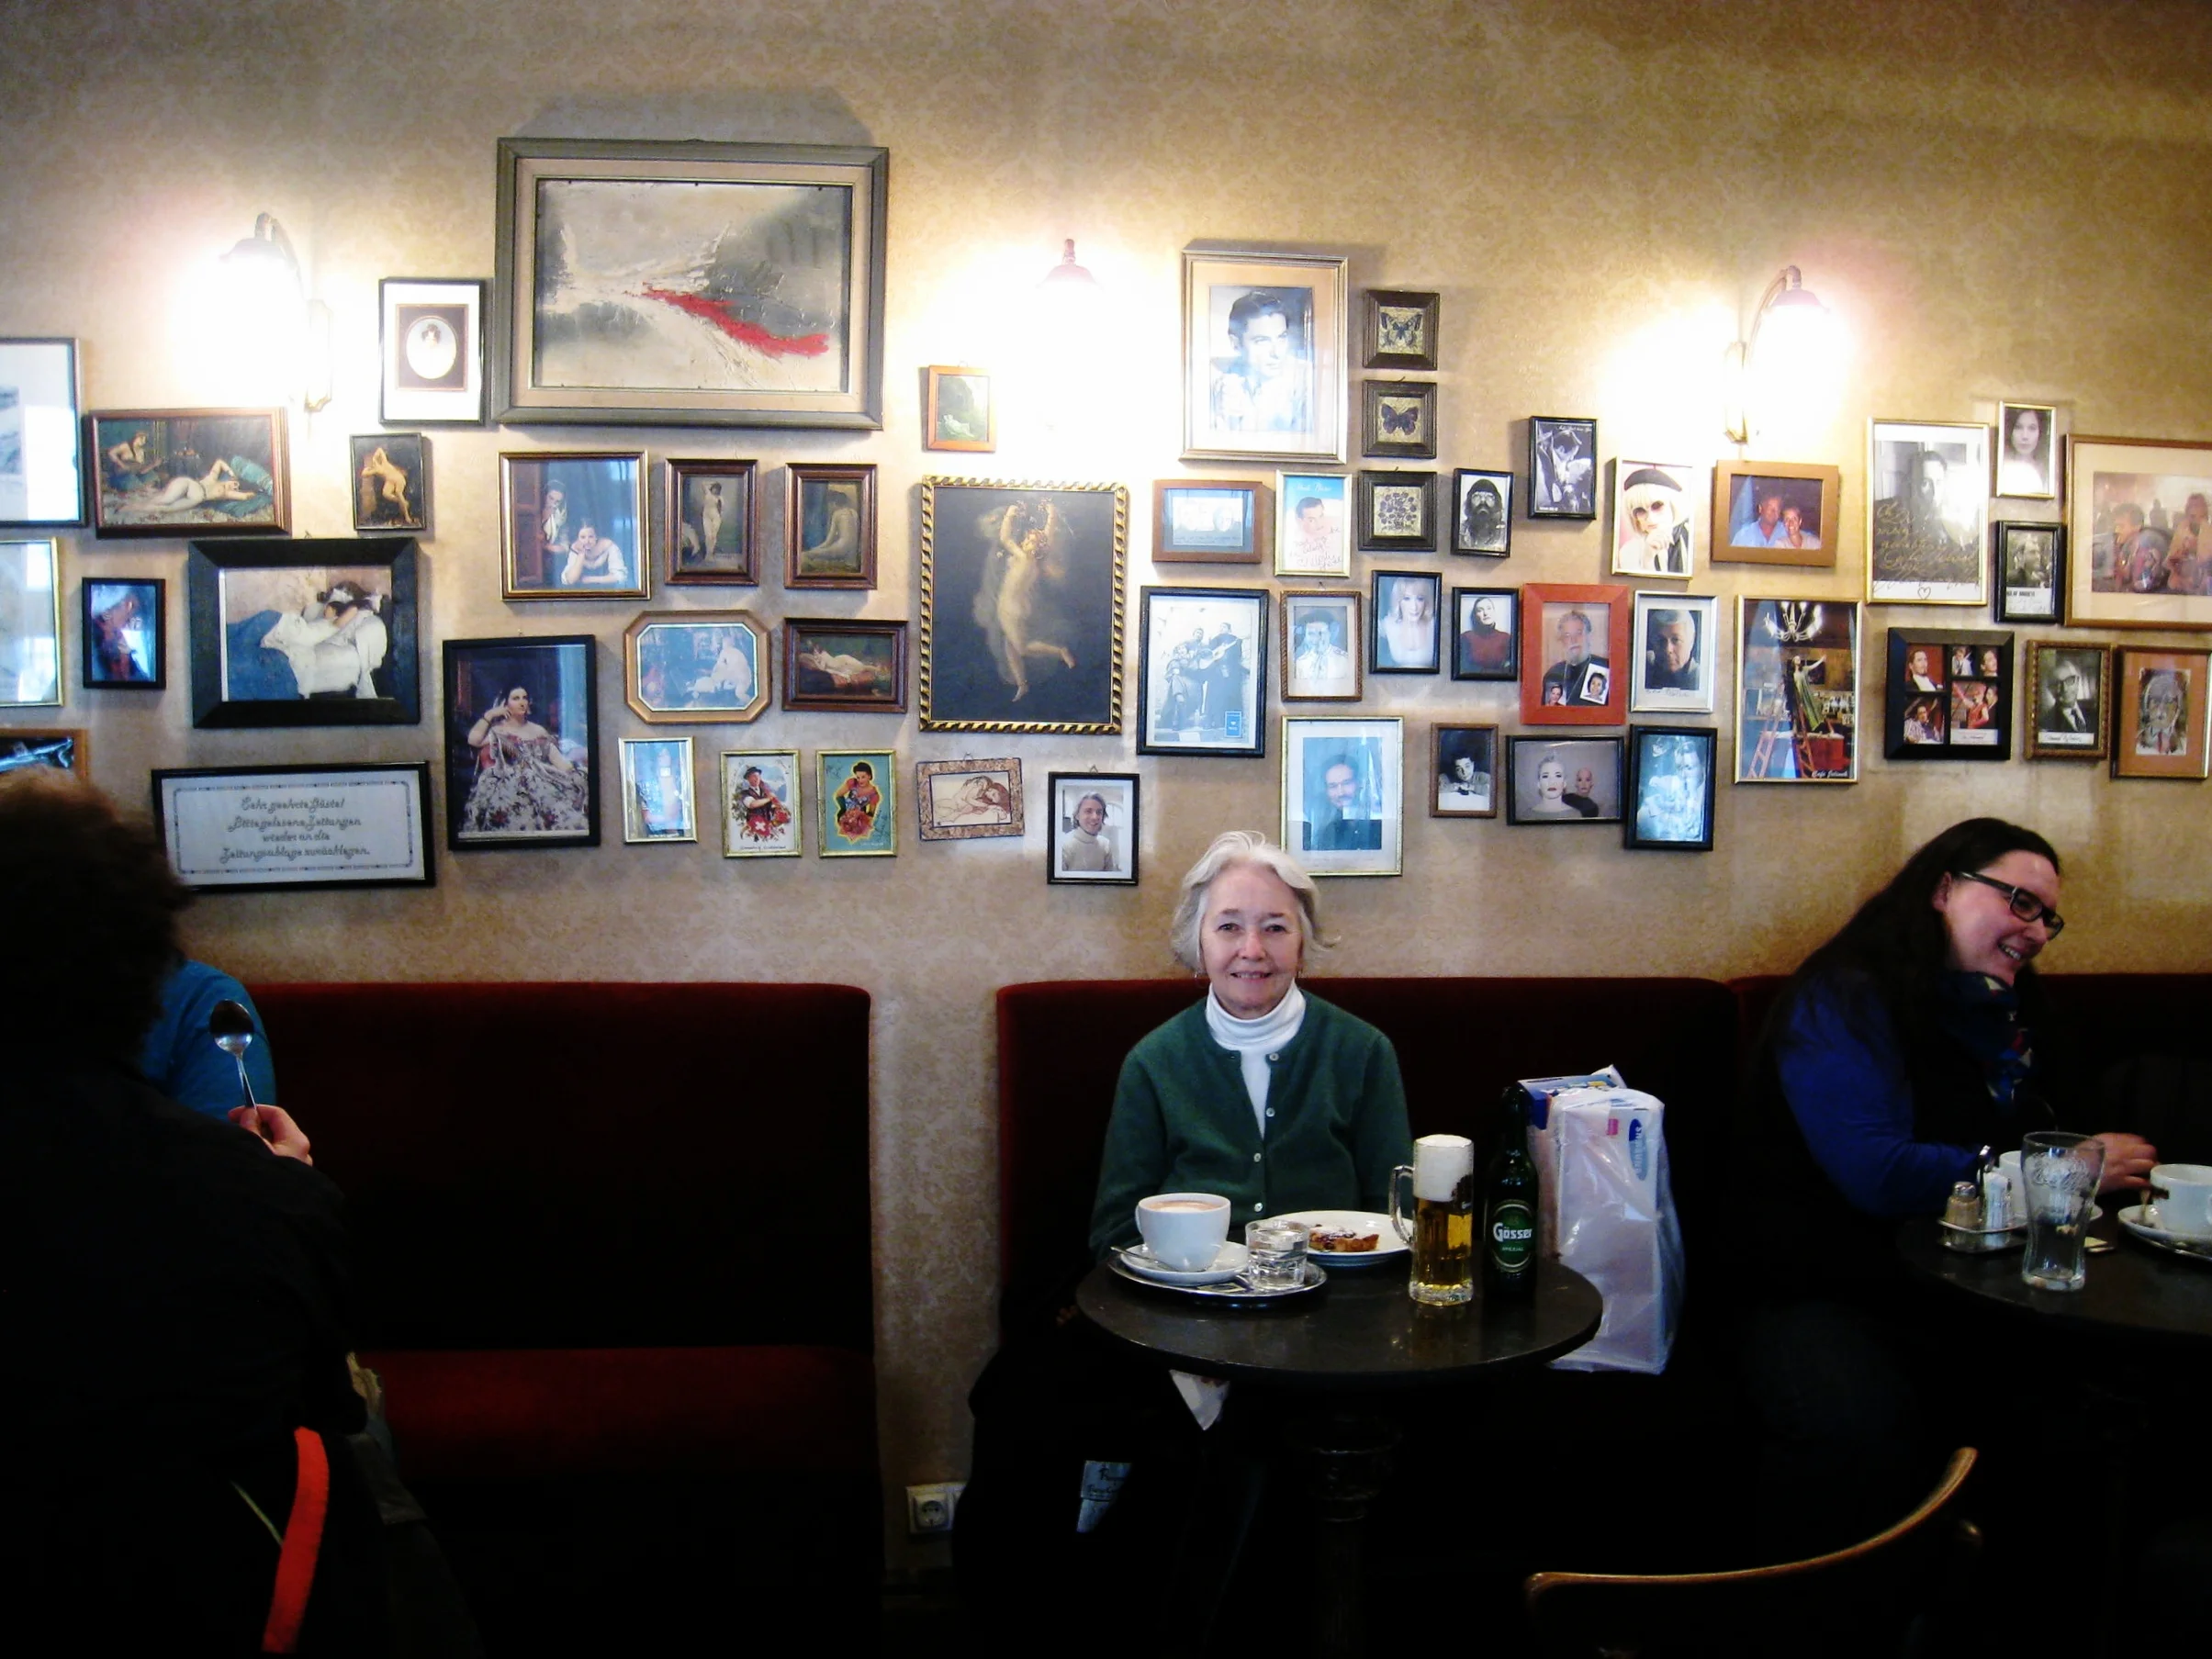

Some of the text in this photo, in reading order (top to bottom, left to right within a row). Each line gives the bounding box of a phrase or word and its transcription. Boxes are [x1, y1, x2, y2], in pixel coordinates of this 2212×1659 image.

[268, 798, 309, 813] geehrte
[305, 814, 361, 832] Zeitungen
[263, 829, 331, 843] wieder an die
[1492, 1222, 1533, 1242] Gösser
